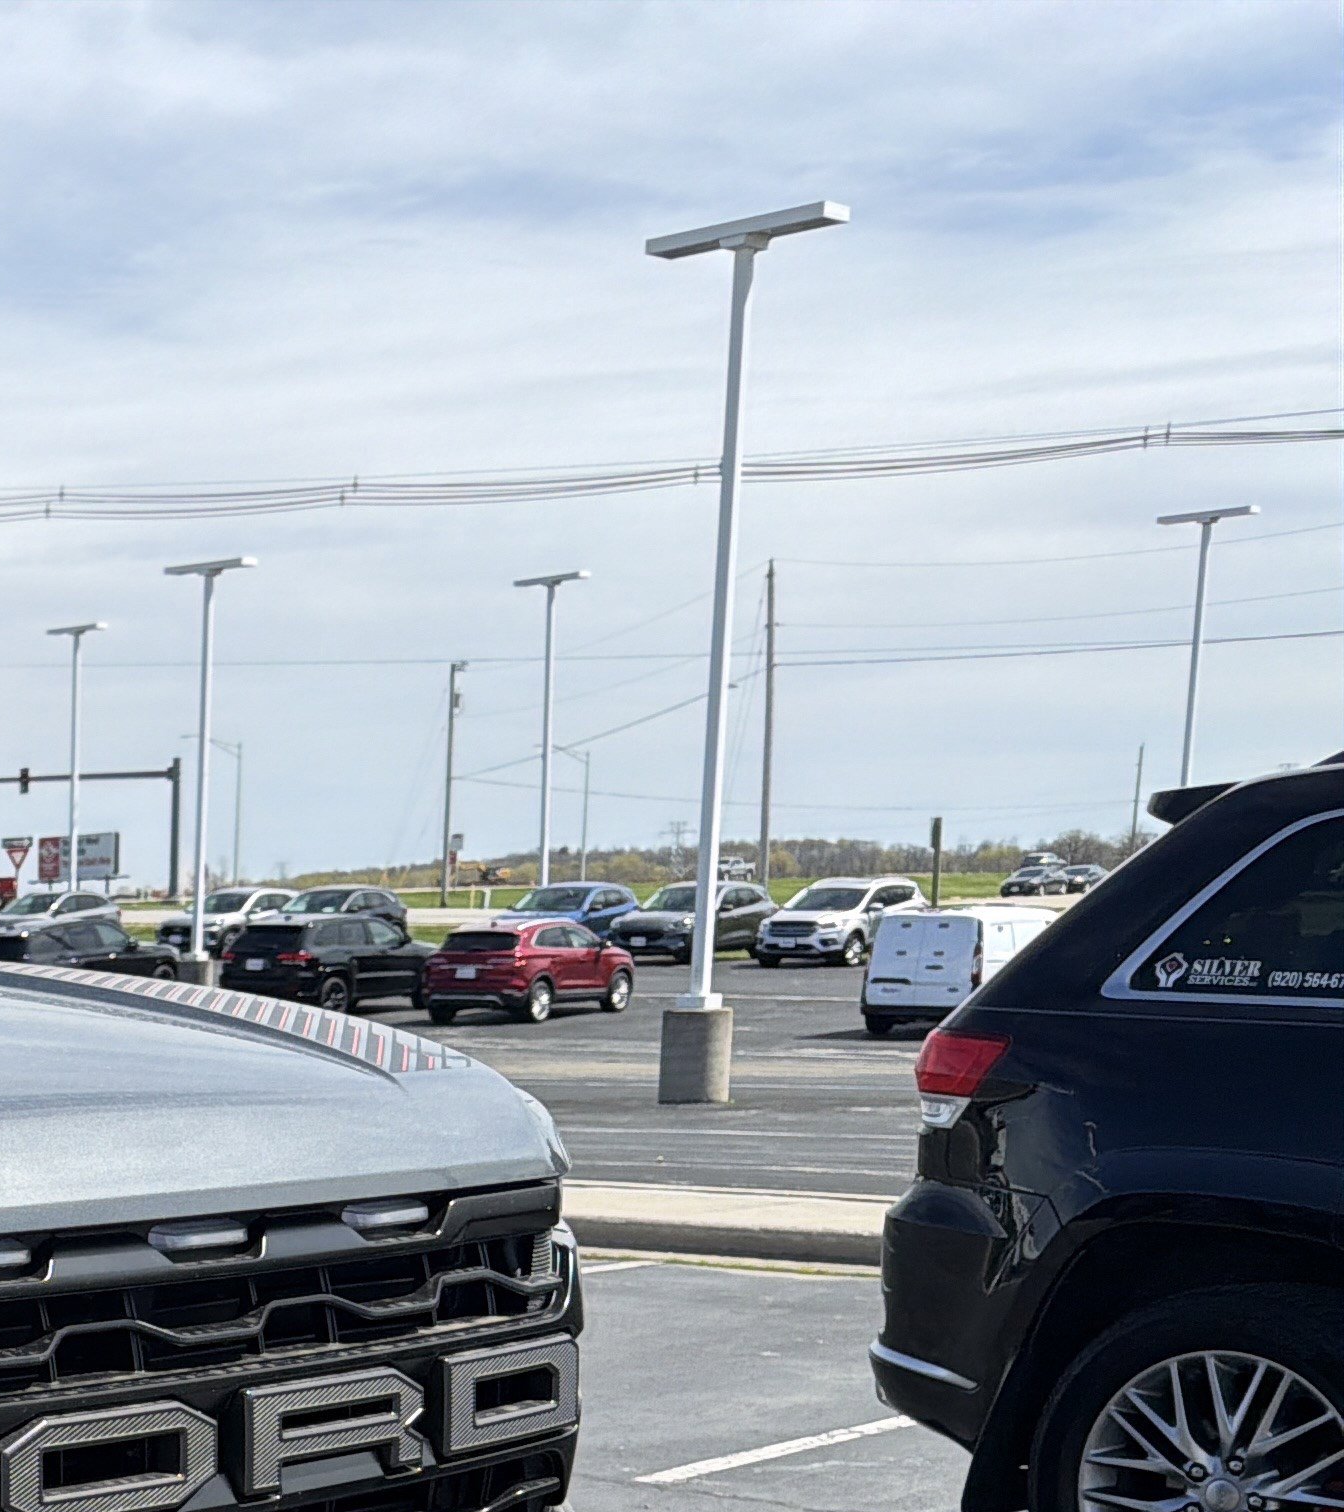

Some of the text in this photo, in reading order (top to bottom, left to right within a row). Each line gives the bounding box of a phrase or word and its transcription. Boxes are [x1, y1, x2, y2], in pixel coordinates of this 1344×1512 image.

[1192, 957, 1262, 977] SILVER
[1188, 976, 1250, 987] SERVICES
[1268, 971, 1303, 989] (920)
